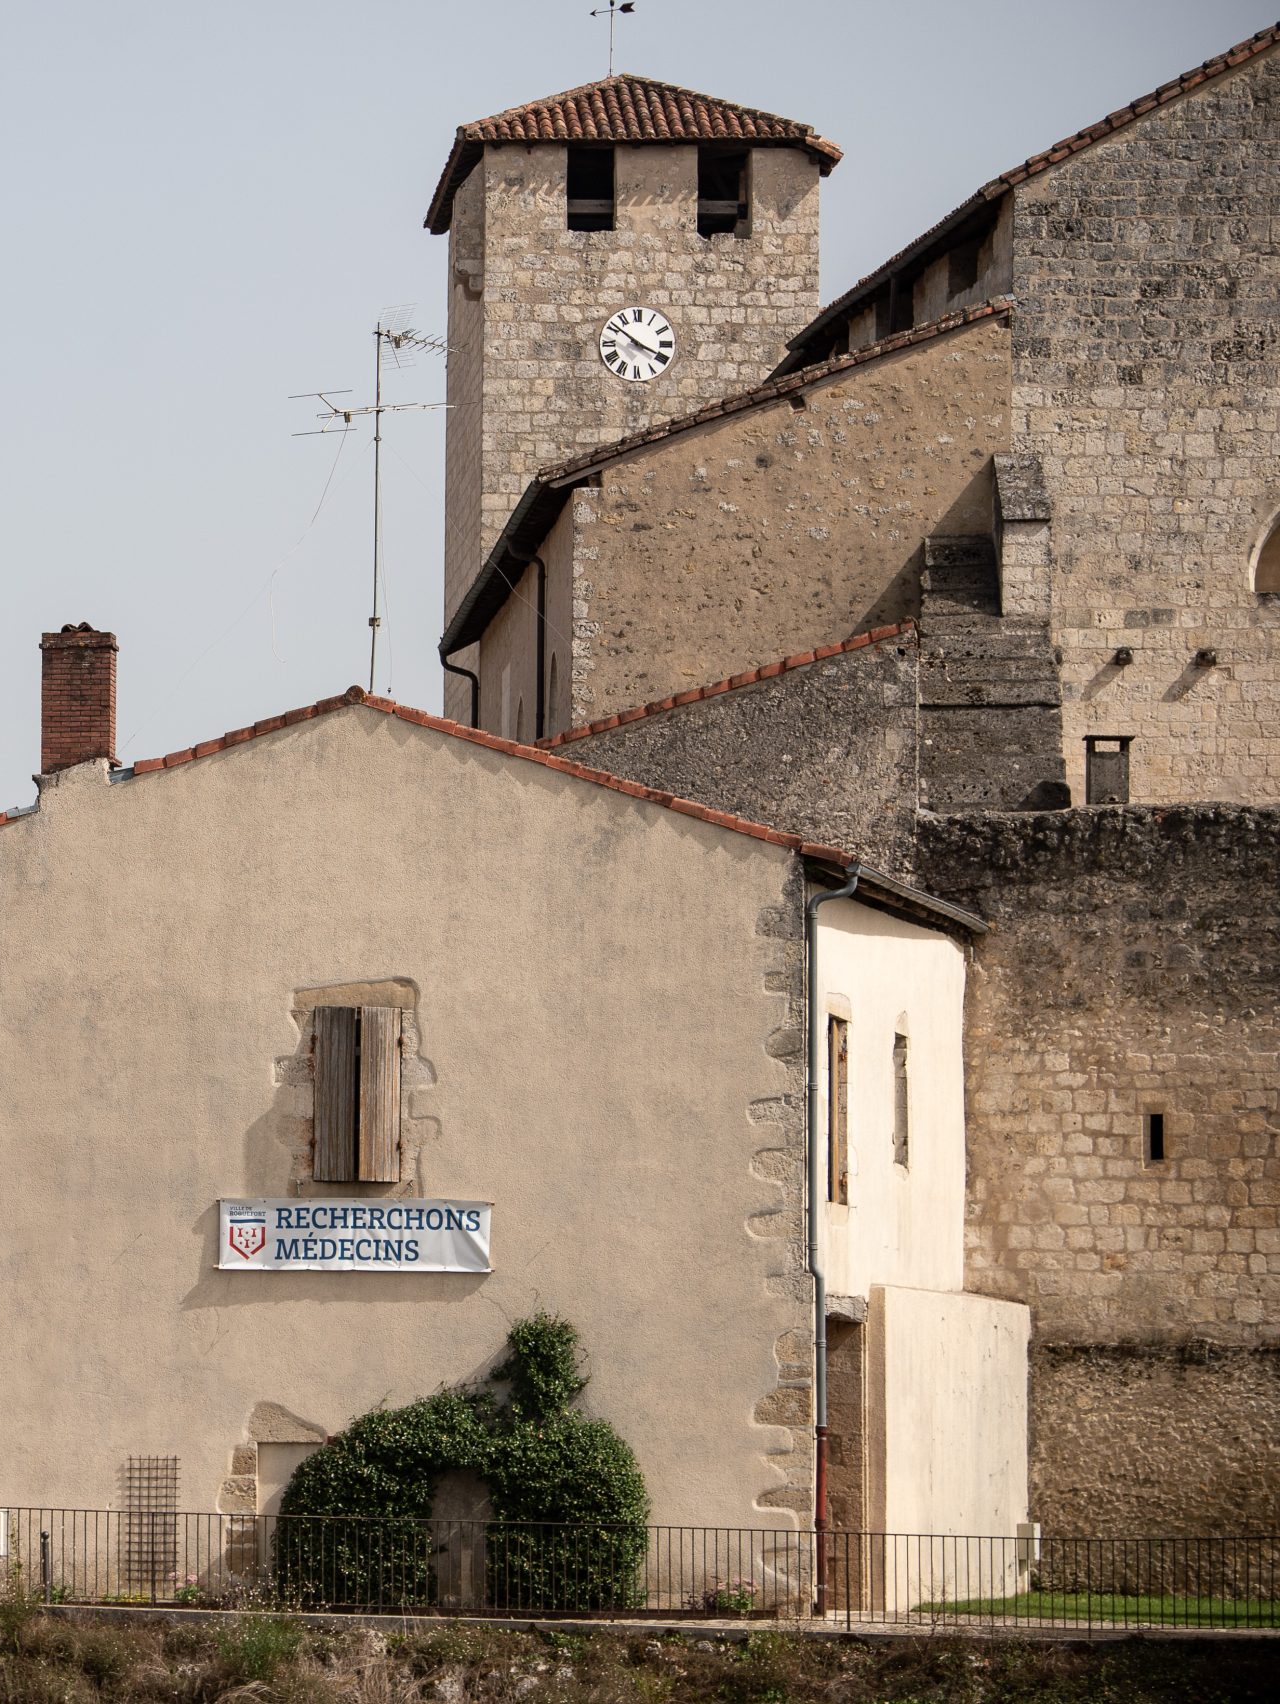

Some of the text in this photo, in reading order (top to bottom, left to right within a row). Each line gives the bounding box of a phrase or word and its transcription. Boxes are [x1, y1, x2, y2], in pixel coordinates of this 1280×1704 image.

[647, 313, 657, 326] I
[655, 325, 669, 336] II
[659, 340, 673, 349] III
[275, 1207, 481, 1232] RECHERCHONS
[274, 1231, 420, 1262] MÉDECINS
